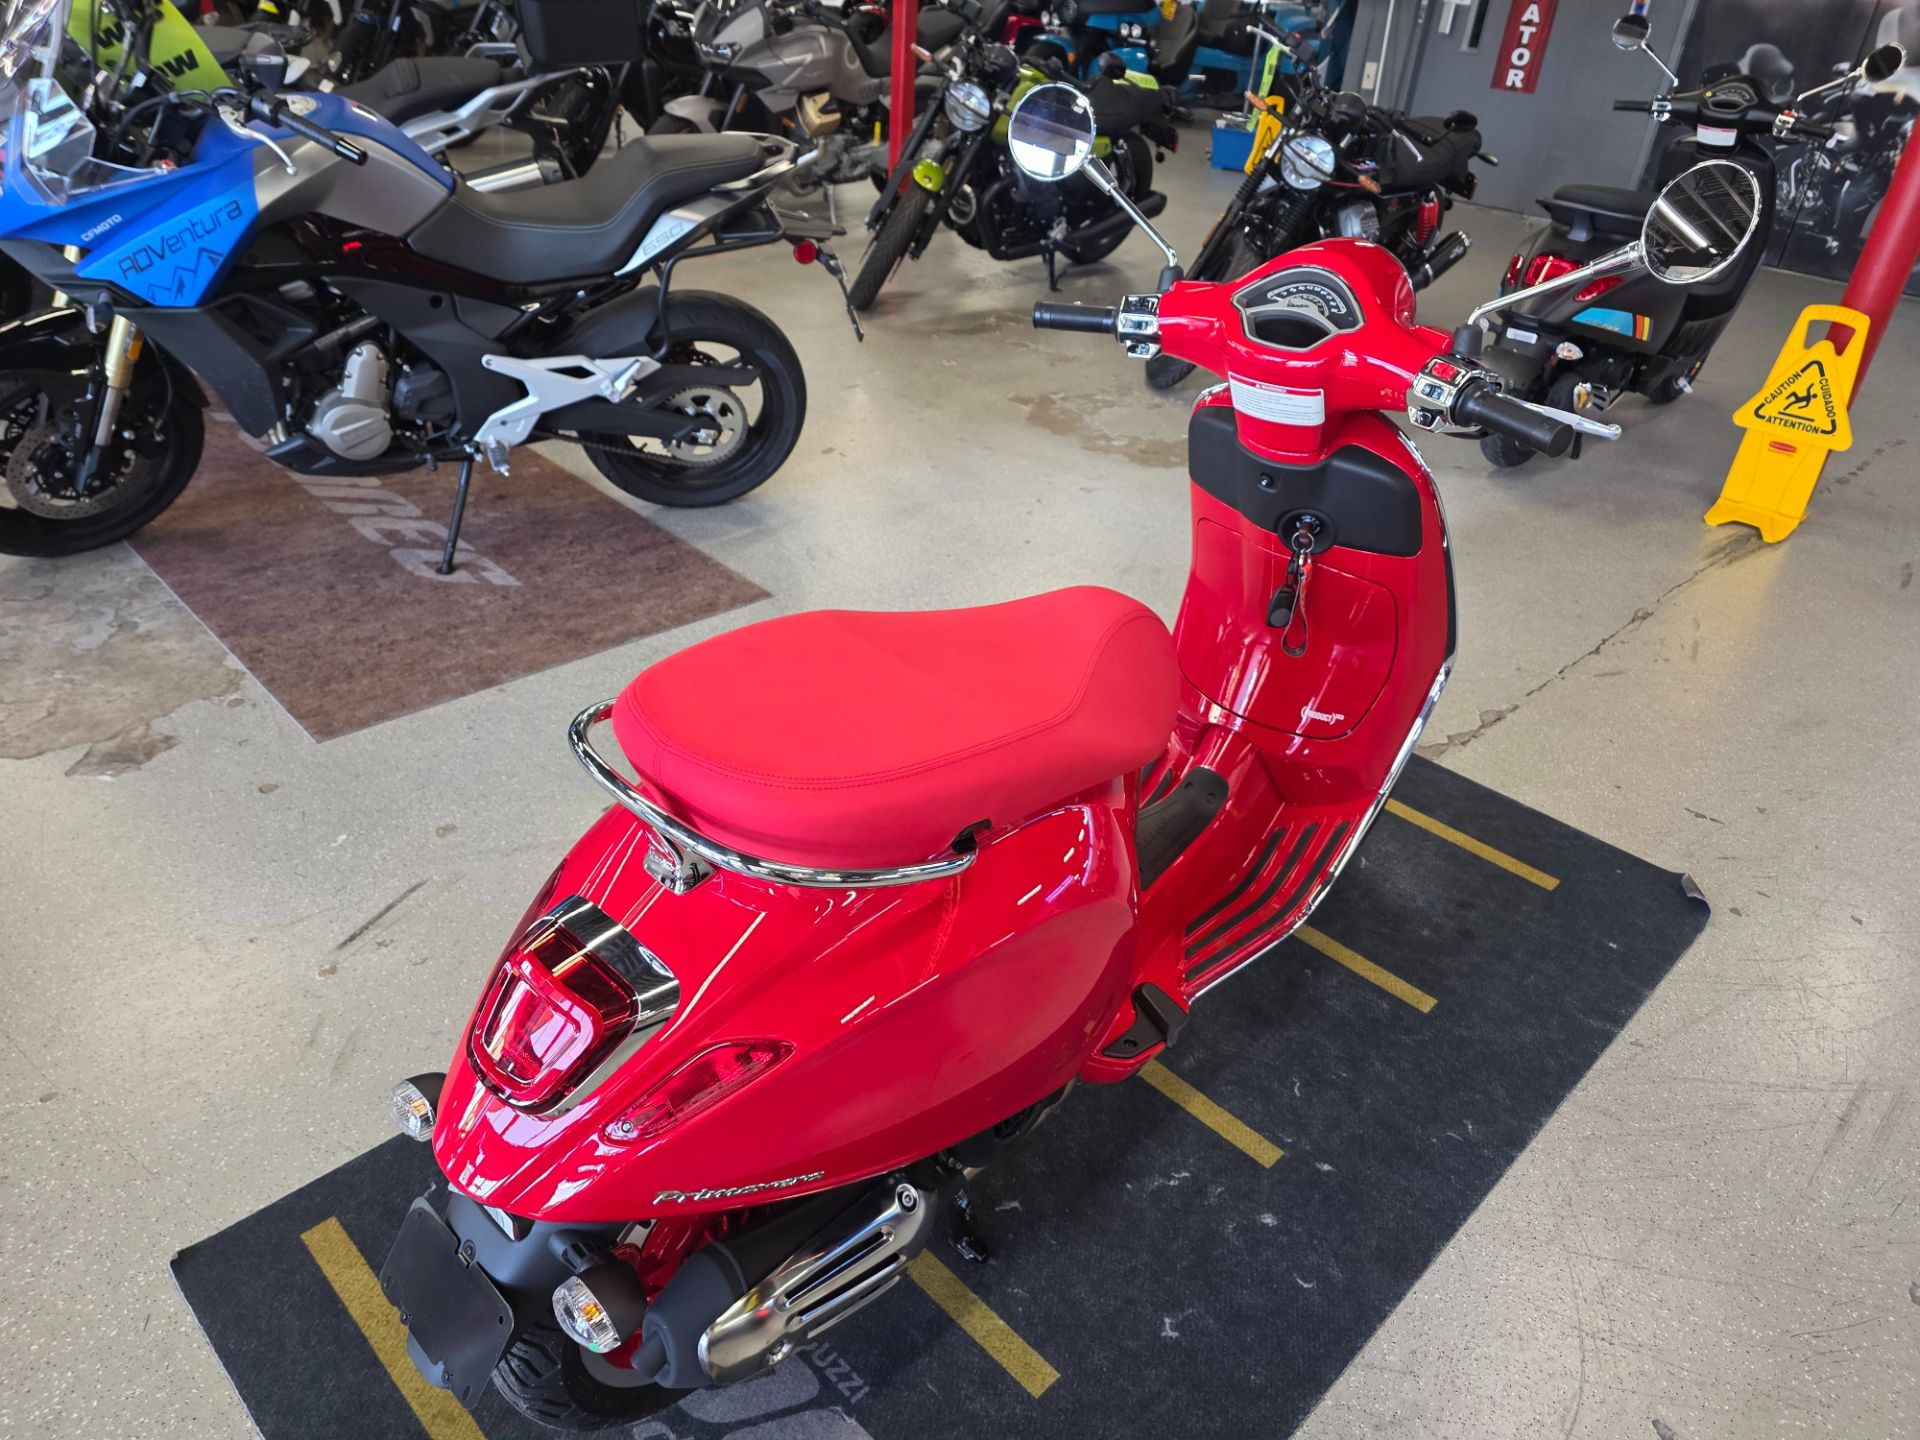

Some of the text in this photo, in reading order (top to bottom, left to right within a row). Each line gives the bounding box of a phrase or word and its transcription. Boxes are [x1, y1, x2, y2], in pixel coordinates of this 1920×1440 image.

[80, 213, 123, 242] CFMOTO
[1763, 370, 1803, 405] CAUTION
[1818, 377, 1837, 419] CUIDADO
[1764, 415, 1821, 434] ATTENTION
[808, 1341, 871, 1404] UZZI
